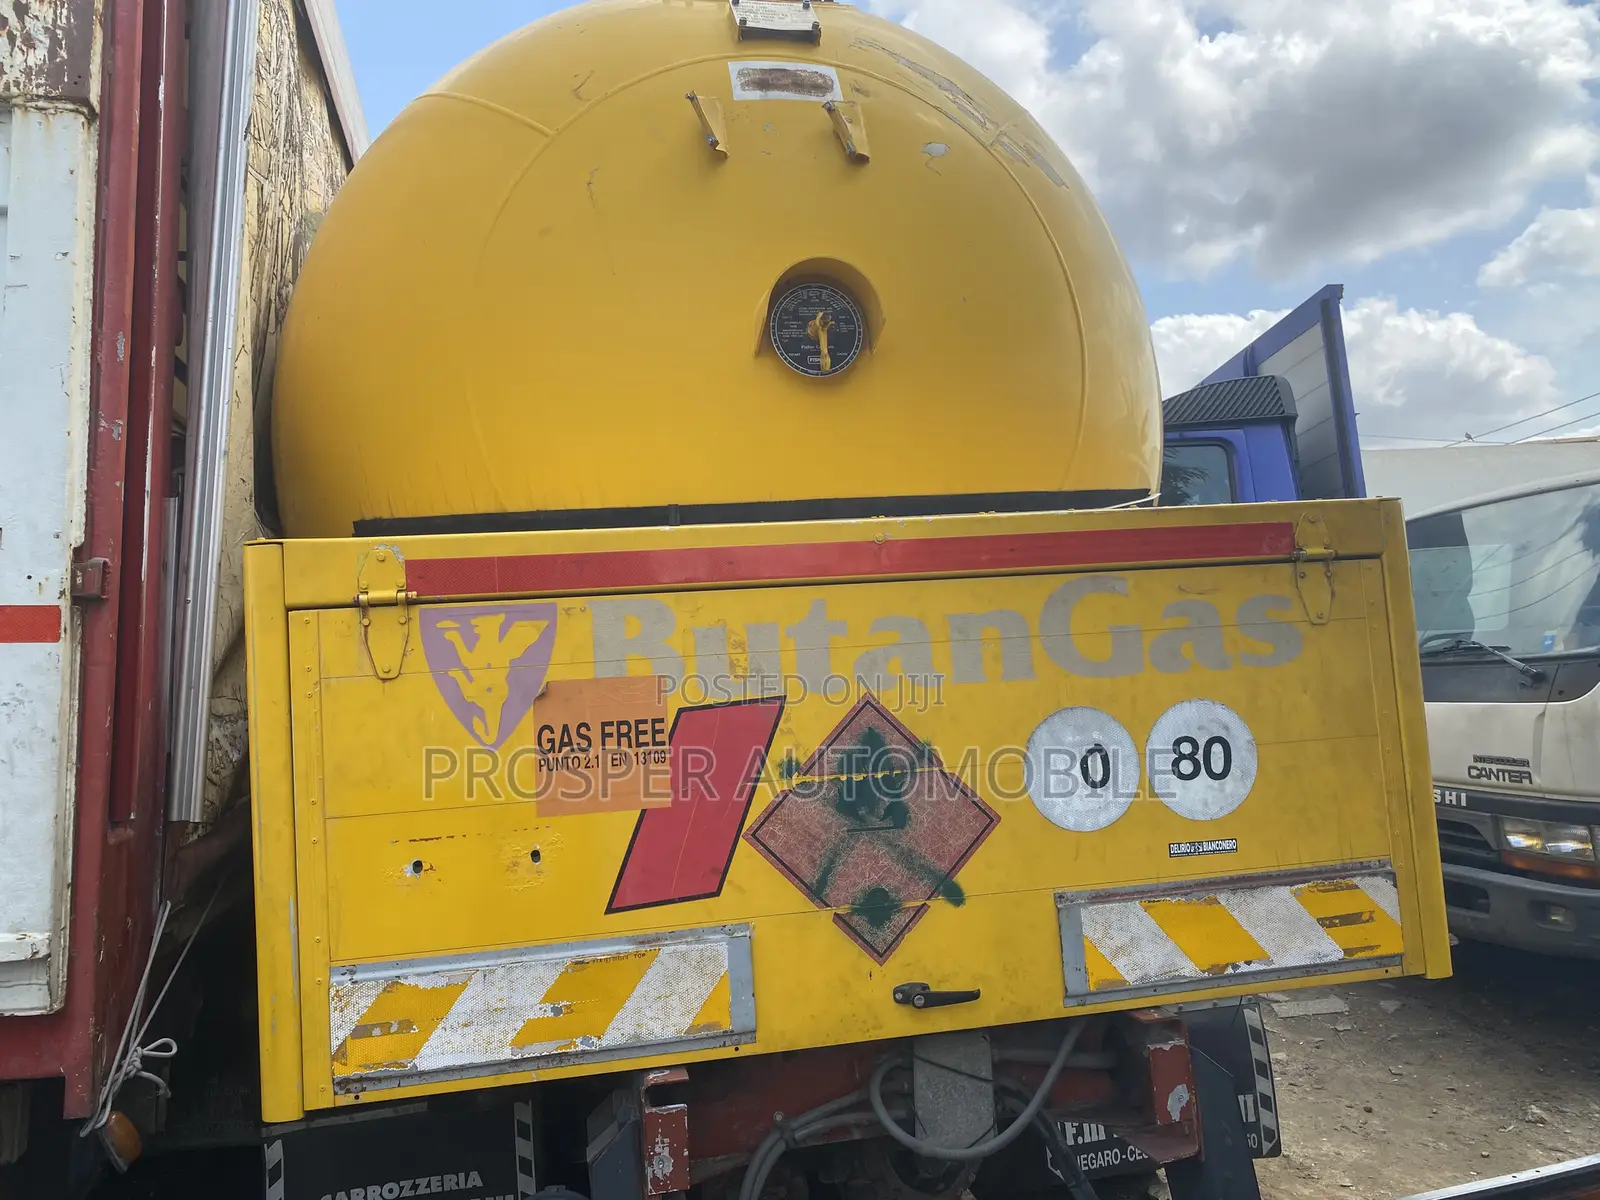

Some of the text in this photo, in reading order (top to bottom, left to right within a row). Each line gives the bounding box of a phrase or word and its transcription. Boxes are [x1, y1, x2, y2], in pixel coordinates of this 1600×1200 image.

[586, 574, 1304, 700] ButanGas
[537, 718, 666, 755] GAS FREE
[539, 749, 666, 772] PUNTO 2.1 EN 13109
[1080, 743, 1110, 789] 0
[1171, 735, 1233, 780] 80
[1467, 765, 1533, 785] CANTER
[1202, 839, 1237, 851] BIANCONERO
